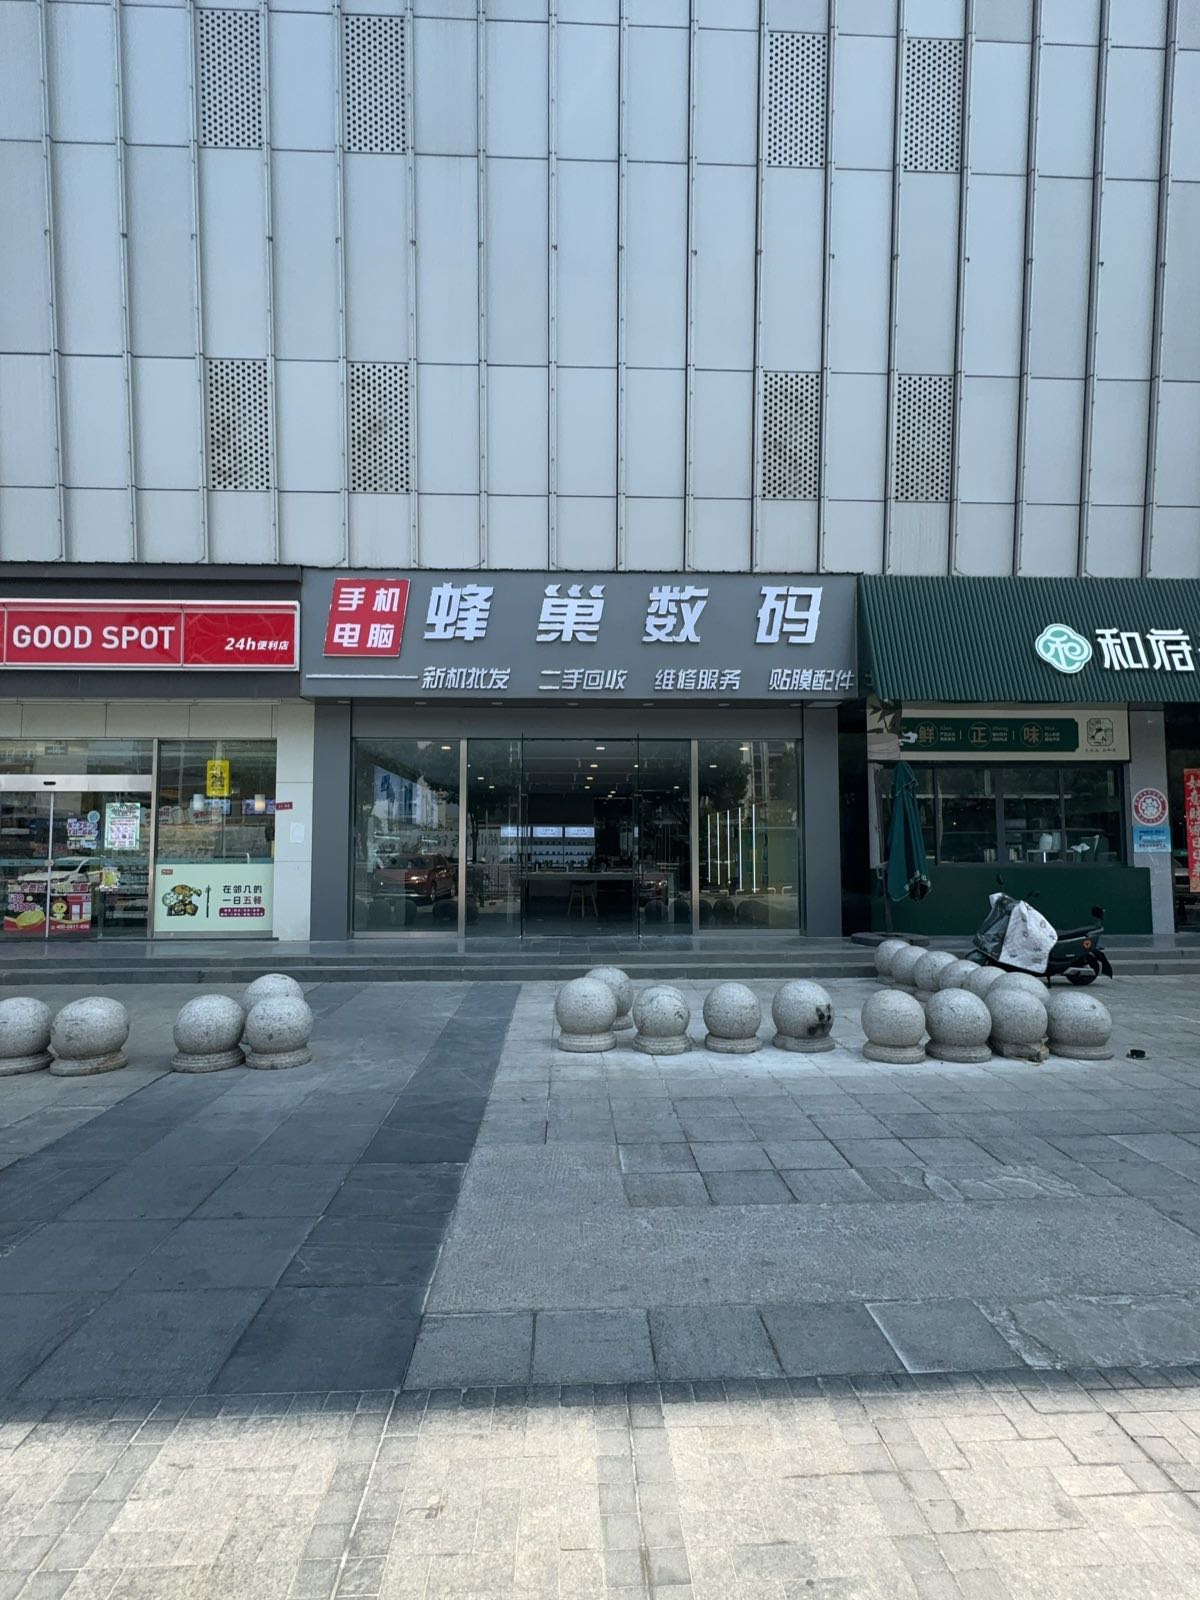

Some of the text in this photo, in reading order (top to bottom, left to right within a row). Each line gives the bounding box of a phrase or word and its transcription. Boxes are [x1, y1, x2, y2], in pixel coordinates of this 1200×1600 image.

[338, 587, 400, 612] 手机
[424, 582, 823, 645] 蜂巢数码
[13, 625, 175, 650] GOOD SPOT
[225, 637, 289, 652] 24h便利店
[333, 623, 395, 648] 电脑
[1095, 628, 1200, 671] 和府
[422, 666, 854, 692] 新机批发 二手回收 维修服务 贴膜配件
[971, 726, 987, 743] 正
[1024, 726, 1040, 743] 味
[223, 885, 262, 894] 在邻几的
